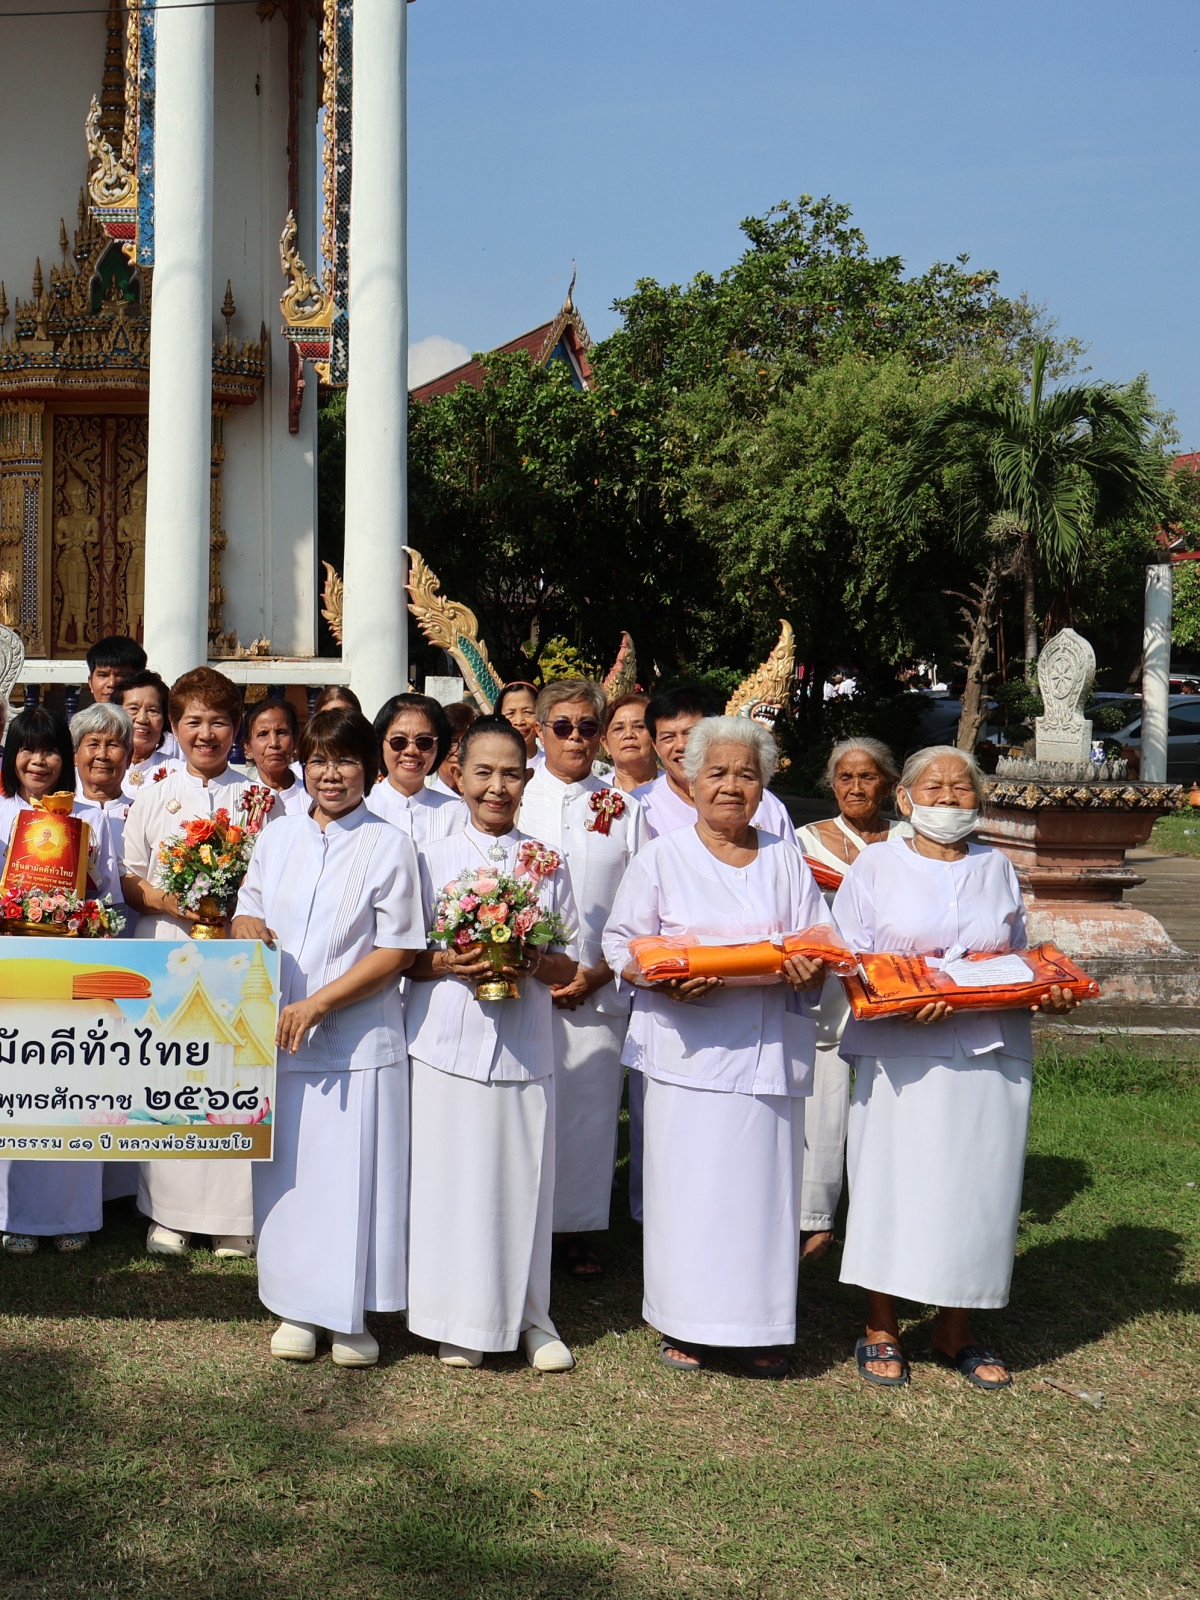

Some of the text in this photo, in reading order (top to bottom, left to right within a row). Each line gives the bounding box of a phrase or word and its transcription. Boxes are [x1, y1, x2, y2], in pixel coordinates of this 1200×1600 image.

[144, 1085, 259, 1111] ๒๕๖๘
[69, 1138, 93, 1150] ๘๑
[100, 1134, 112, 1149] ปี
[118, 1134, 252, 1150] หลวงพ่อธัมมชโย
